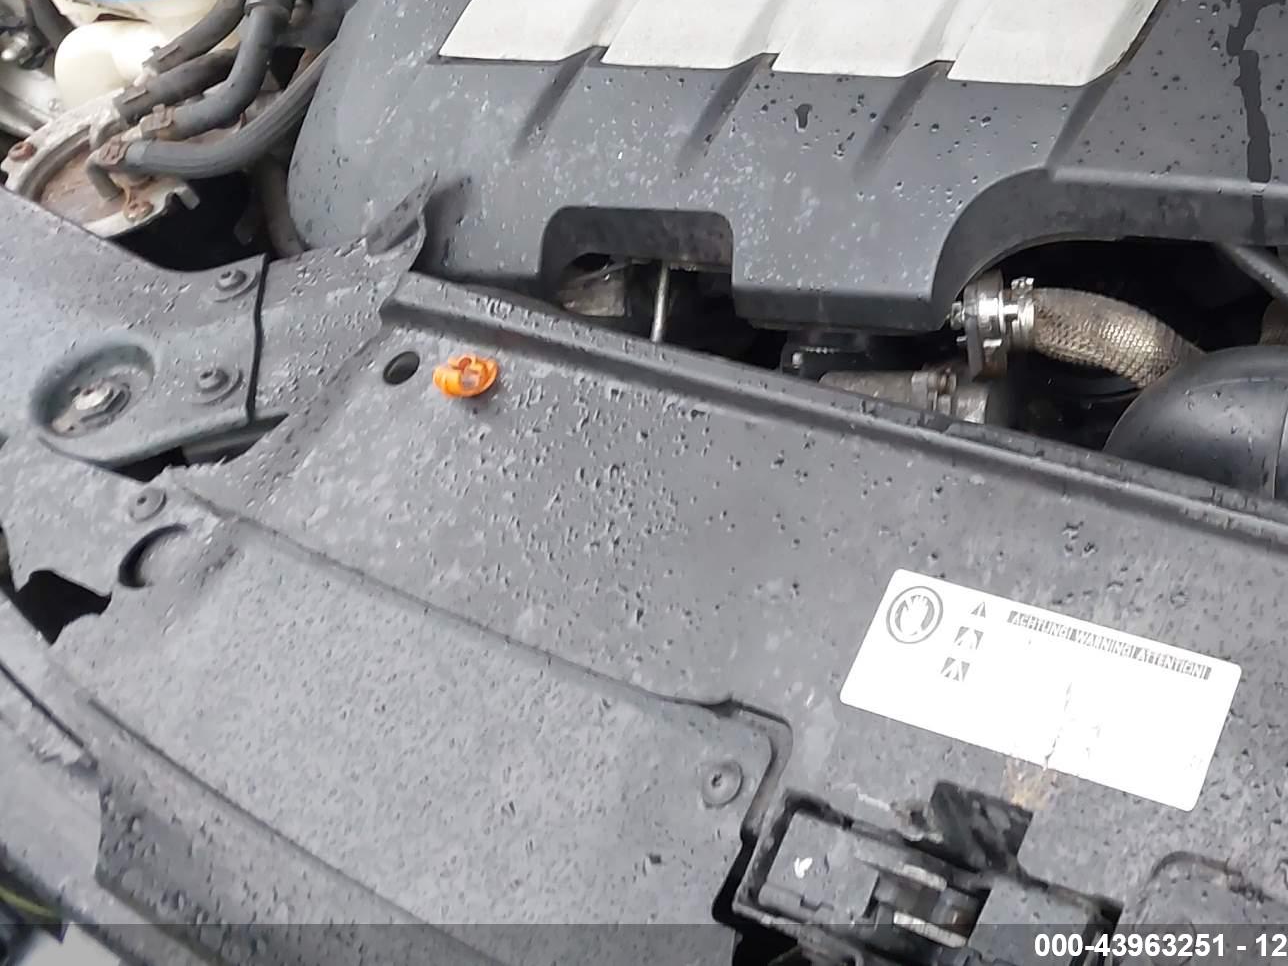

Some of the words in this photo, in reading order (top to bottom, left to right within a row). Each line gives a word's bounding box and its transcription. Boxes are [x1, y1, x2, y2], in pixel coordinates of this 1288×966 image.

[1011, 611, 1071, 640] ACHTUNG!
[1075, 628, 1136, 659] WARNING!
[1136, 646, 1209, 679] ATTENTION!
